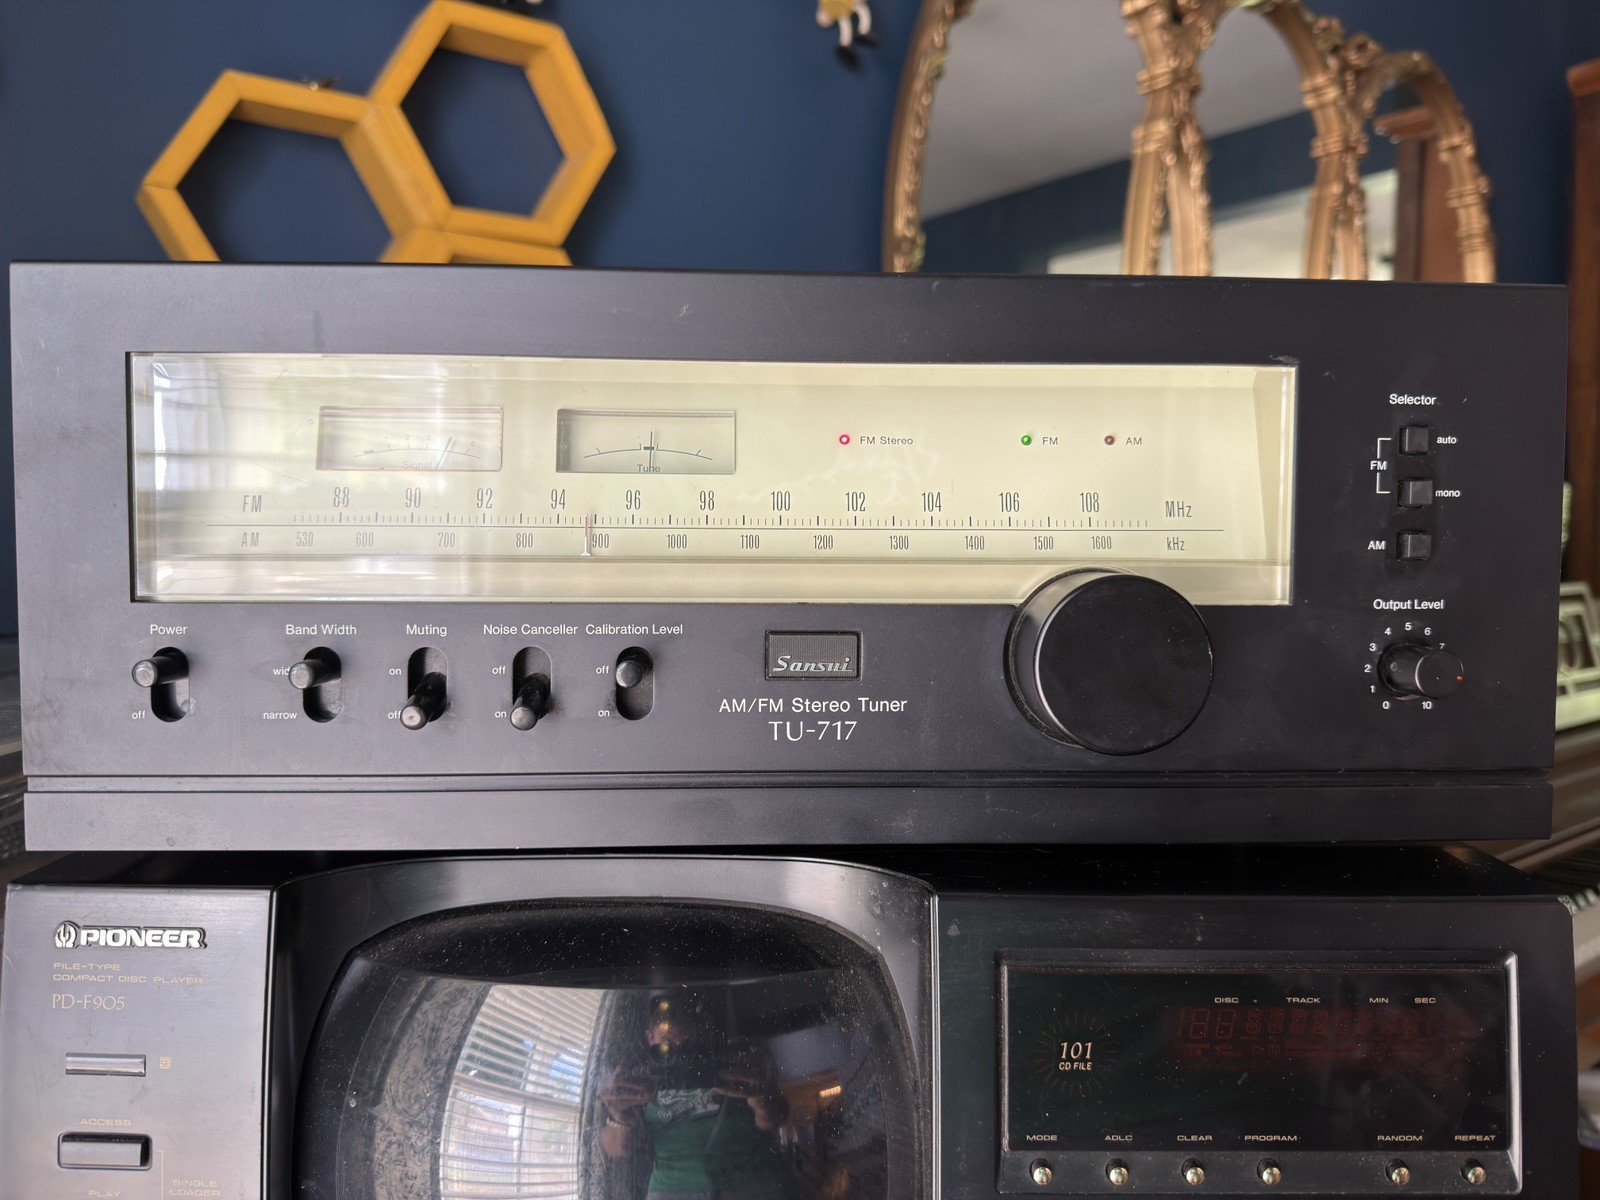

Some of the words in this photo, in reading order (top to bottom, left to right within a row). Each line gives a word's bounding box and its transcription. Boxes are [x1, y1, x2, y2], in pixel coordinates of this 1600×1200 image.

[1390, 394, 1436, 405] Selector
[860, 436, 875, 445] FM
[880, 436, 913, 445] Stereo
[1042, 437, 1058, 445] FM
[1126, 437, 1142, 445] AM
[402, 461, 433, 470] Signal
[637, 464, 661, 473] Tune
[1370, 461, 1387, 470] FM
[242, 495, 262, 512] FM
[333, 487, 349, 508] 88
[405, 487, 421, 508] 90
[476, 488, 493, 509] 92
[550, 489, 566, 509] 94
[626, 490, 641, 510] 96
[700, 490, 715, 511] 98
[770, 491, 790, 511] 100
[845, 491, 866, 512] 102
[921, 492, 942, 512] 104
[999, 492, 1020, 512] 106
[1080, 492, 1100, 513] 108
[1165, 501, 1192, 518] MHz
[242, 532, 259, 547] AM
[296, 532, 314, 547] 530
[356, 532, 374, 547] 600
[438, 532, 455, 548] 700
[516, 533, 533, 548] 800
[592, 534, 609, 549] 900
[667, 534, 687, 549] 1000
[740, 534, 760, 549] 1100
[813, 535, 834, 549] 1200
[889, 535, 909, 550] 1300
[965, 535, 985, 550] 1400
[1033, 535, 1054, 550] 1500
[1091, 535, 1112, 550] 1600
[1167, 537, 1185, 551] kHz
[1368, 541, 1386, 550] AM
[1373, 599, 1412, 611] Output
[1414, 599, 1444, 610] Level
[150, 624, 188, 635] Power
[286, 624, 317, 635] Band
[321, 624, 357, 635] Width
[406, 624, 447, 637] Muting
[483, 624, 517, 635] Noise
[521, 624, 578, 635] Canceller
[586, 624, 649, 635] Calibration
[652, 624, 683, 635] Level
[1405, 622, 1412, 631] 5
[1369, 643, 1376, 651] 3
[772, 655, 854, 672] Sansui
[1364, 664, 1371, 672] 2
[272, 666, 290, 676] wid
[492, 666, 506, 674] off
[596, 666, 609, 674] off
[719, 698, 783, 713] AM/FM
[792, 698, 850, 712] Stereo
[858, 698, 907, 712] Tuner
[1382, 701, 1389, 709] 0
[1422, 701, 1432, 709] 10
[132, 710, 146, 720] off
[263, 711, 297, 720] narrow
[388, 711, 401, 719] off
[494, 710, 507, 718] on
[768, 721, 858, 741] TU-717
[80, 928, 204, 948] PIONEER
[54, 962, 120, 971] FILE-TYPE
[53, 974, 113, 982] COMPACT
[52, 994, 125, 1010] PD-F905
[1060, 1041, 1093, 1059] 101
[1059, 1061, 1071, 1071] CD
[1073, 1061, 1092, 1071] FILE
[80, 1118, 132, 1126] ACCESS
[172, 1180, 218, 1188] SINGLE
